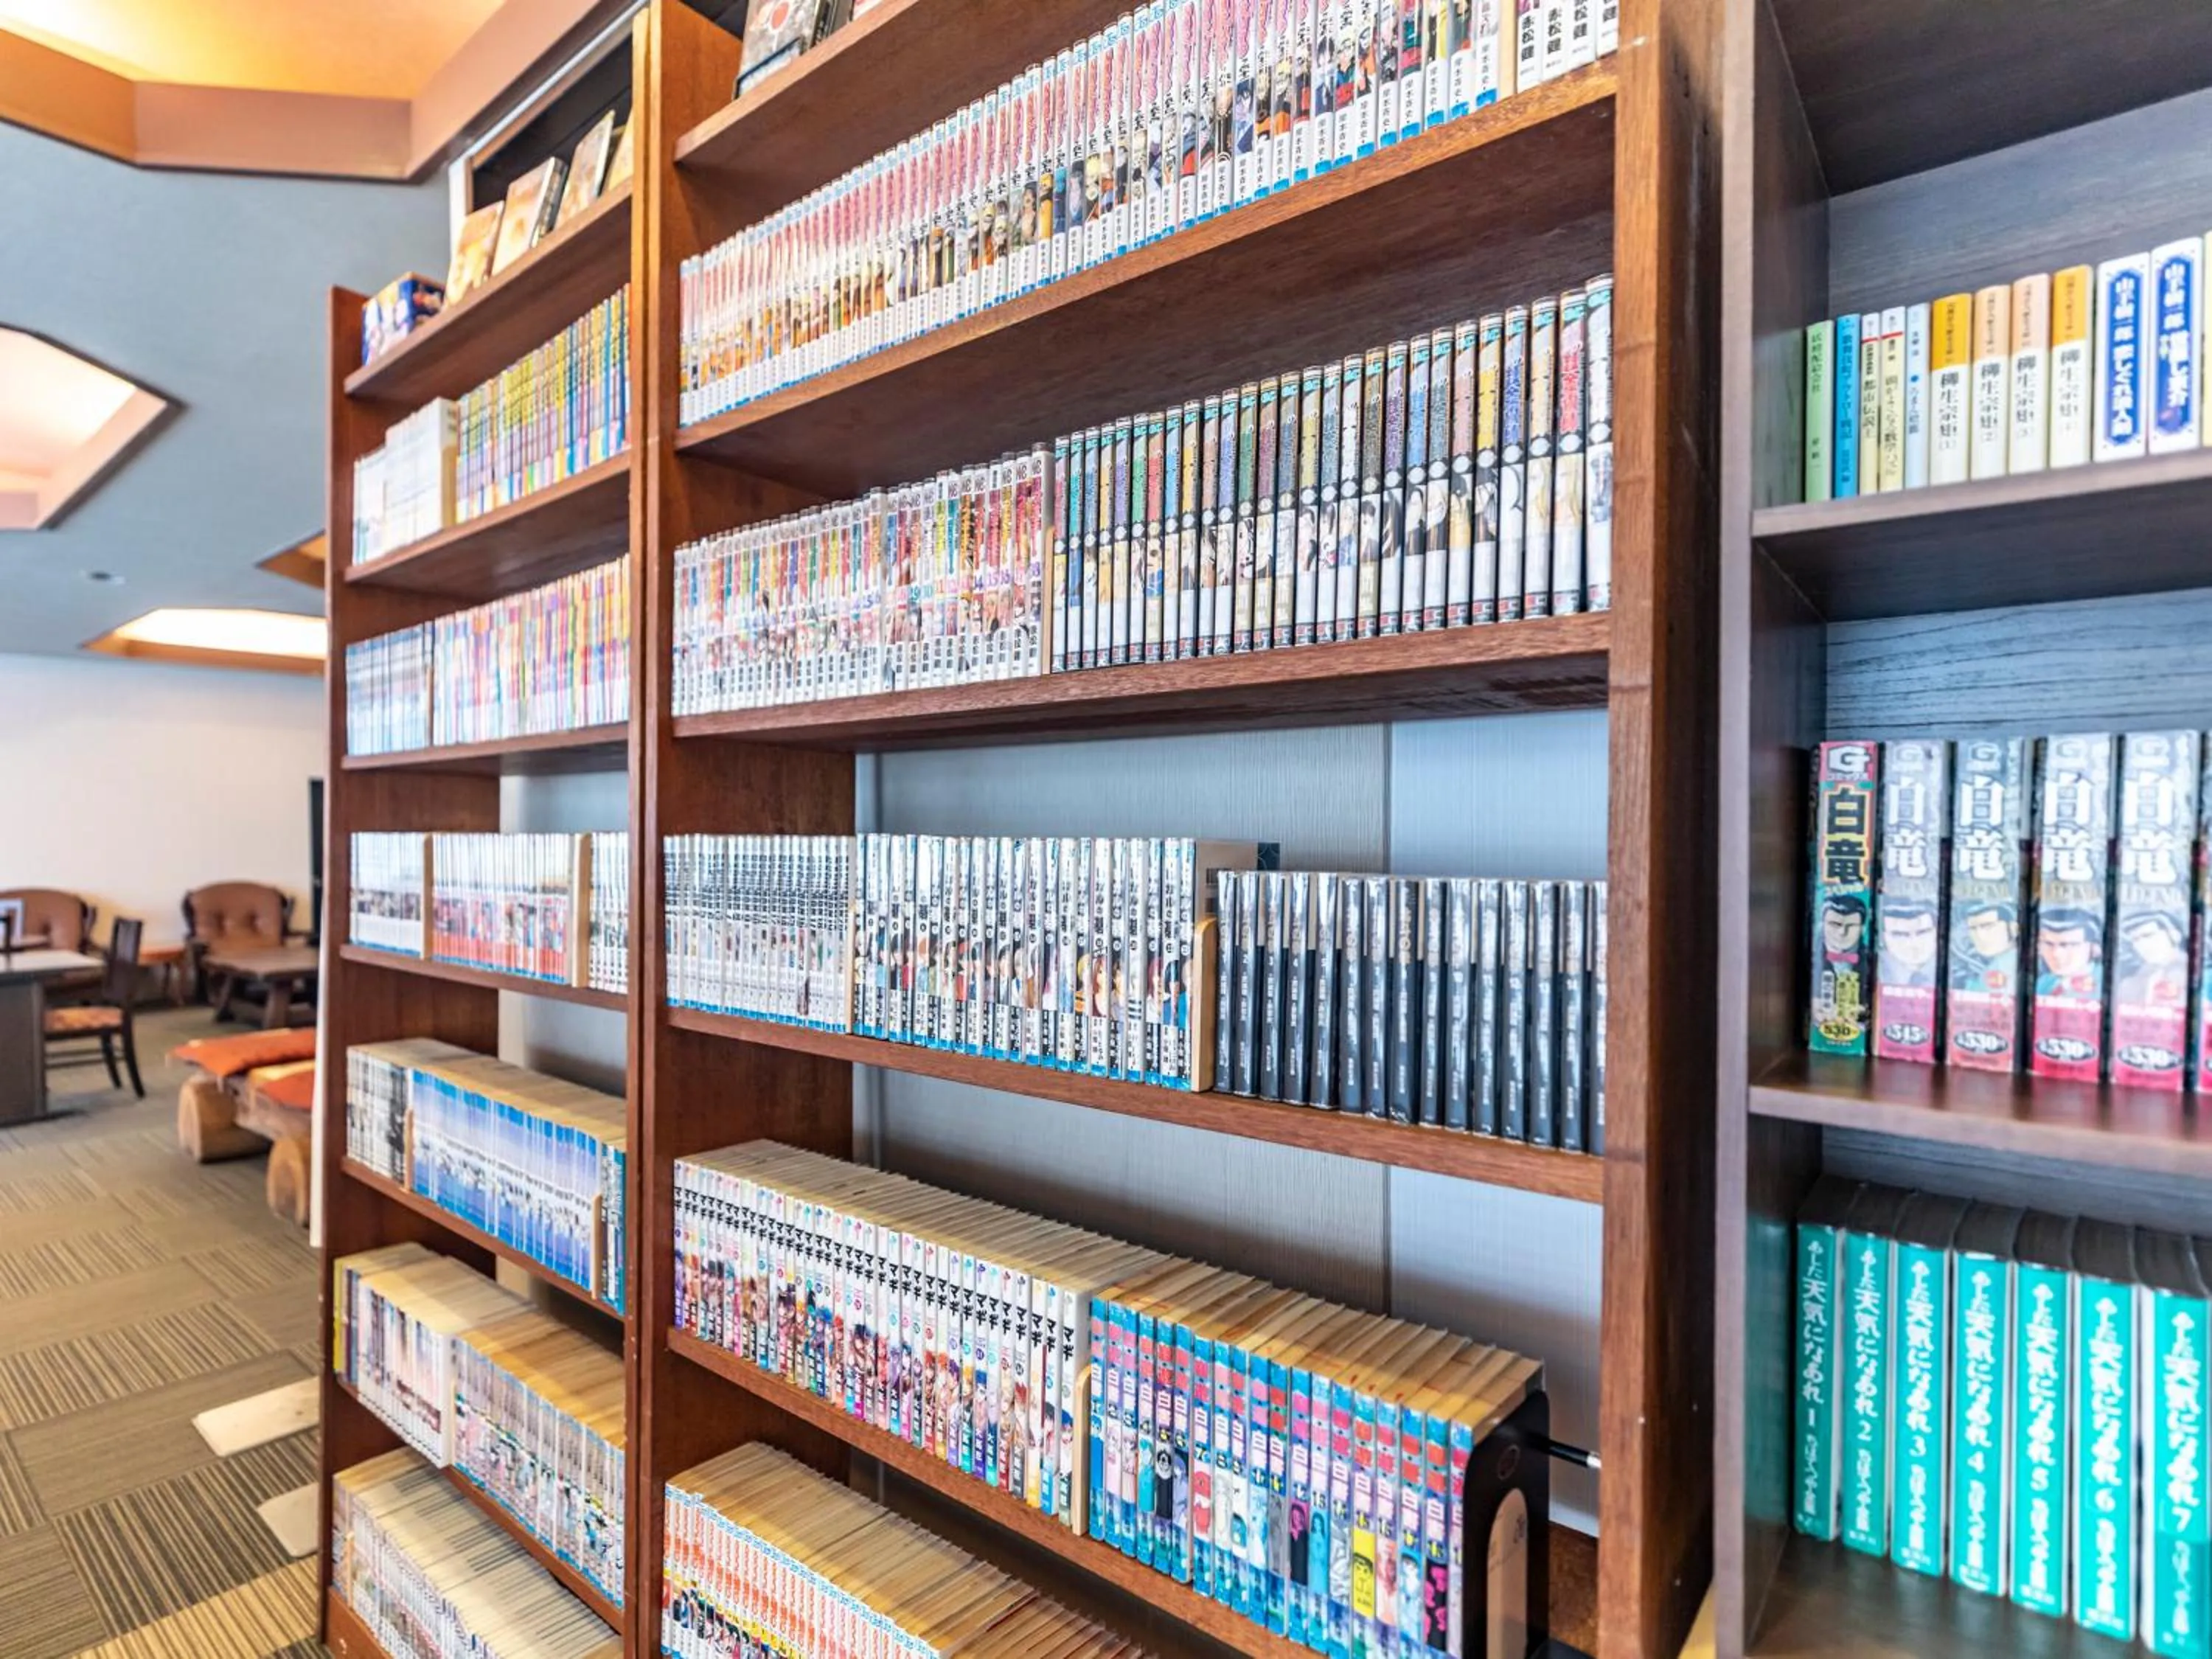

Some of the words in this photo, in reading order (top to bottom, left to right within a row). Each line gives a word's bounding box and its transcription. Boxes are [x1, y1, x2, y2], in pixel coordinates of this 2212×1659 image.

[1521, 15, 1534, 61] 赤松健
[1827, 787, 1869, 885] 白竜
[1958, 774, 2006, 880] 白竜
[2042, 772, 2094, 881] 白竜
[2121, 771, 2177, 883] 白竜
[776, 1222, 785, 1248] マギ
[785, 1224, 796, 1249] マギ
[795, 1228, 804, 1256] マギ
[804, 1232, 813, 1259] マギ
[815, 1234, 824, 1263] マギ
[824, 1237, 832, 1262] マギ
[834, 1242, 843, 1270] マギ
[846, 1245, 853, 1274] マギ
[855, 1249, 864, 1279] マギ
[864, 1253, 874, 1282] マギ
[878, 1256, 887, 1286] マギ
[889, 1263, 900, 1293] マギ
[902, 1265, 913, 1295] マギ
[914, 1270, 922, 1301] マギ
[925, 1275, 936, 1306] マギ
[937, 1278, 948, 1310] マギ
[949, 1284, 961, 1316] マギ
[963, 1288, 975, 1321] マギ
[975, 1293, 988, 1326] マギ
[989, 1297, 1000, 1330] マギ
[1002, 1301, 1012, 1335] マギ
[1016, 1306, 1028, 1340] マギ
[1031, 1312, 1044, 1347] マギ
[1046, 1318, 1057, 1353] マギ
[1062, 1326, 1075, 1361] マギ
[1807, 1408, 1815, 1427] 1
[1857, 1420, 1872, 1441] 2
[1908, 1435, 1927, 1458] 3
[1966, 1450, 1986, 1473] 4
[2030, 1467, 2049, 1492] 5
[2094, 1487, 2116, 1512] 6
[2171, 1506, 2193, 1532] 7
